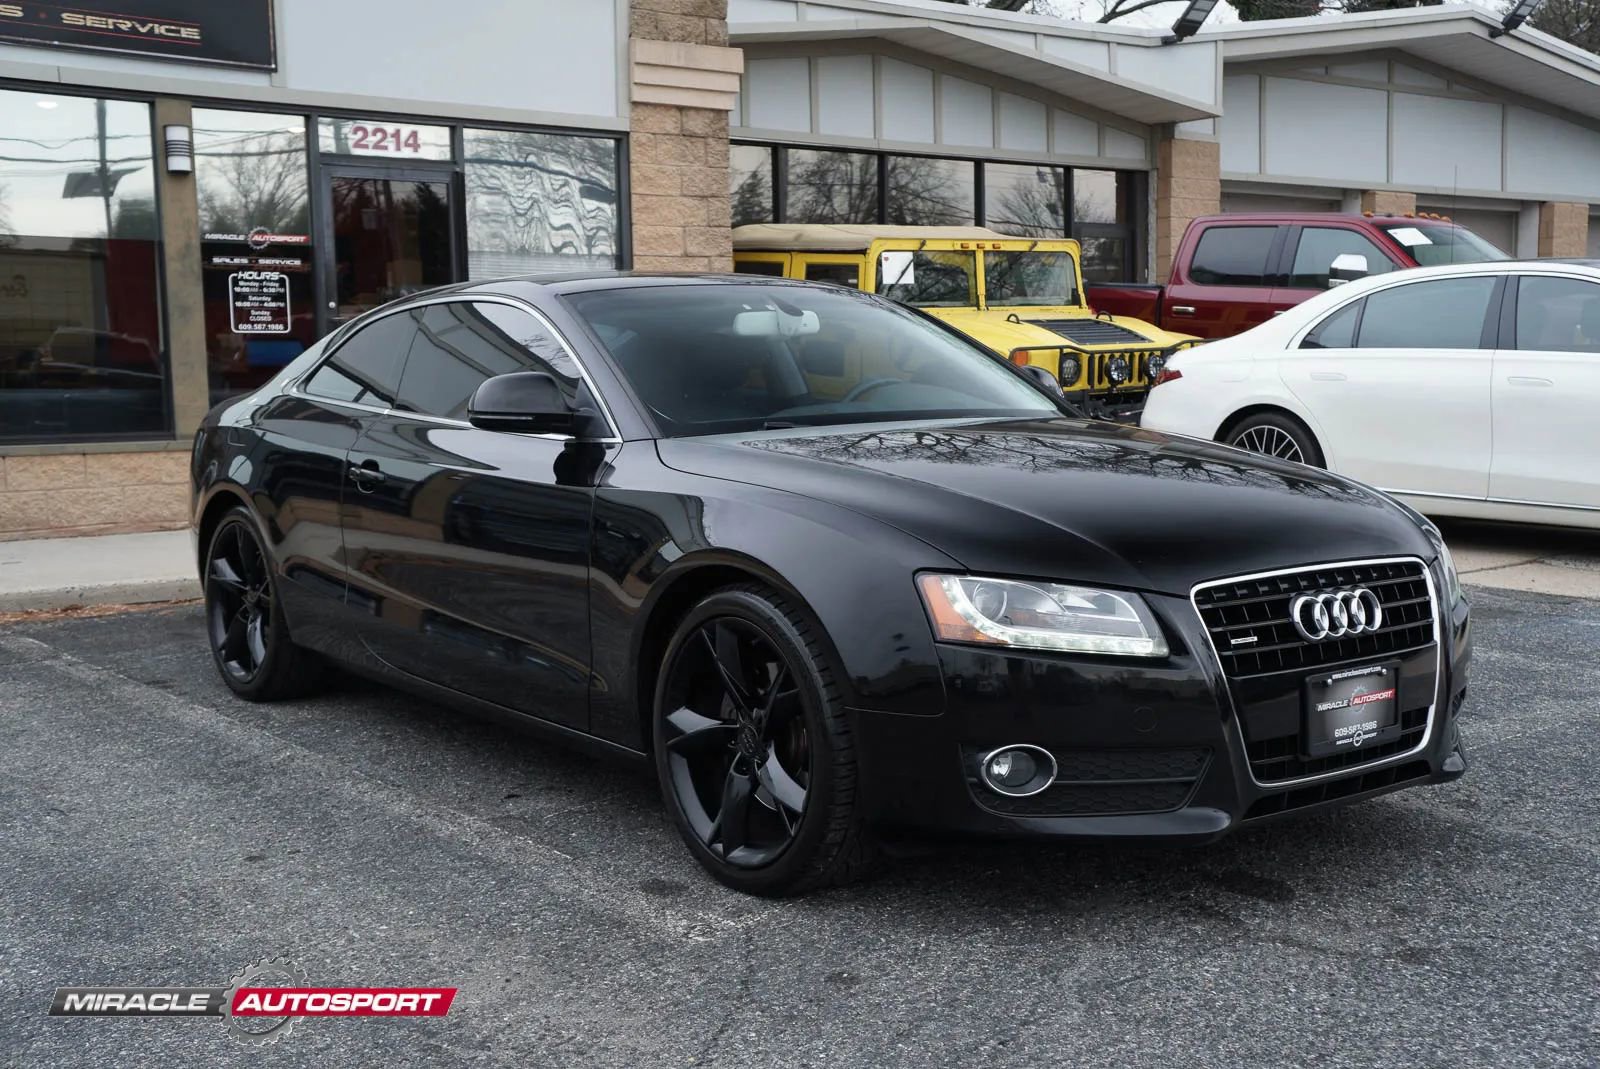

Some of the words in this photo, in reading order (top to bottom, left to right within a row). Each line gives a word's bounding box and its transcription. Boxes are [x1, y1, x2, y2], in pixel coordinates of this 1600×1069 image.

[61, 12, 202, 40] SERVICE
[351, 125, 421, 153] 2214
[204, 233, 246, 241] MIRACLE
[251, 234, 307, 243] AUTOSPORT
[237, 271, 280, 281] HOURS
[1317, 699, 1349, 712] MIRACLE
[1352, 690, 1393, 705] AUTOSPORT
